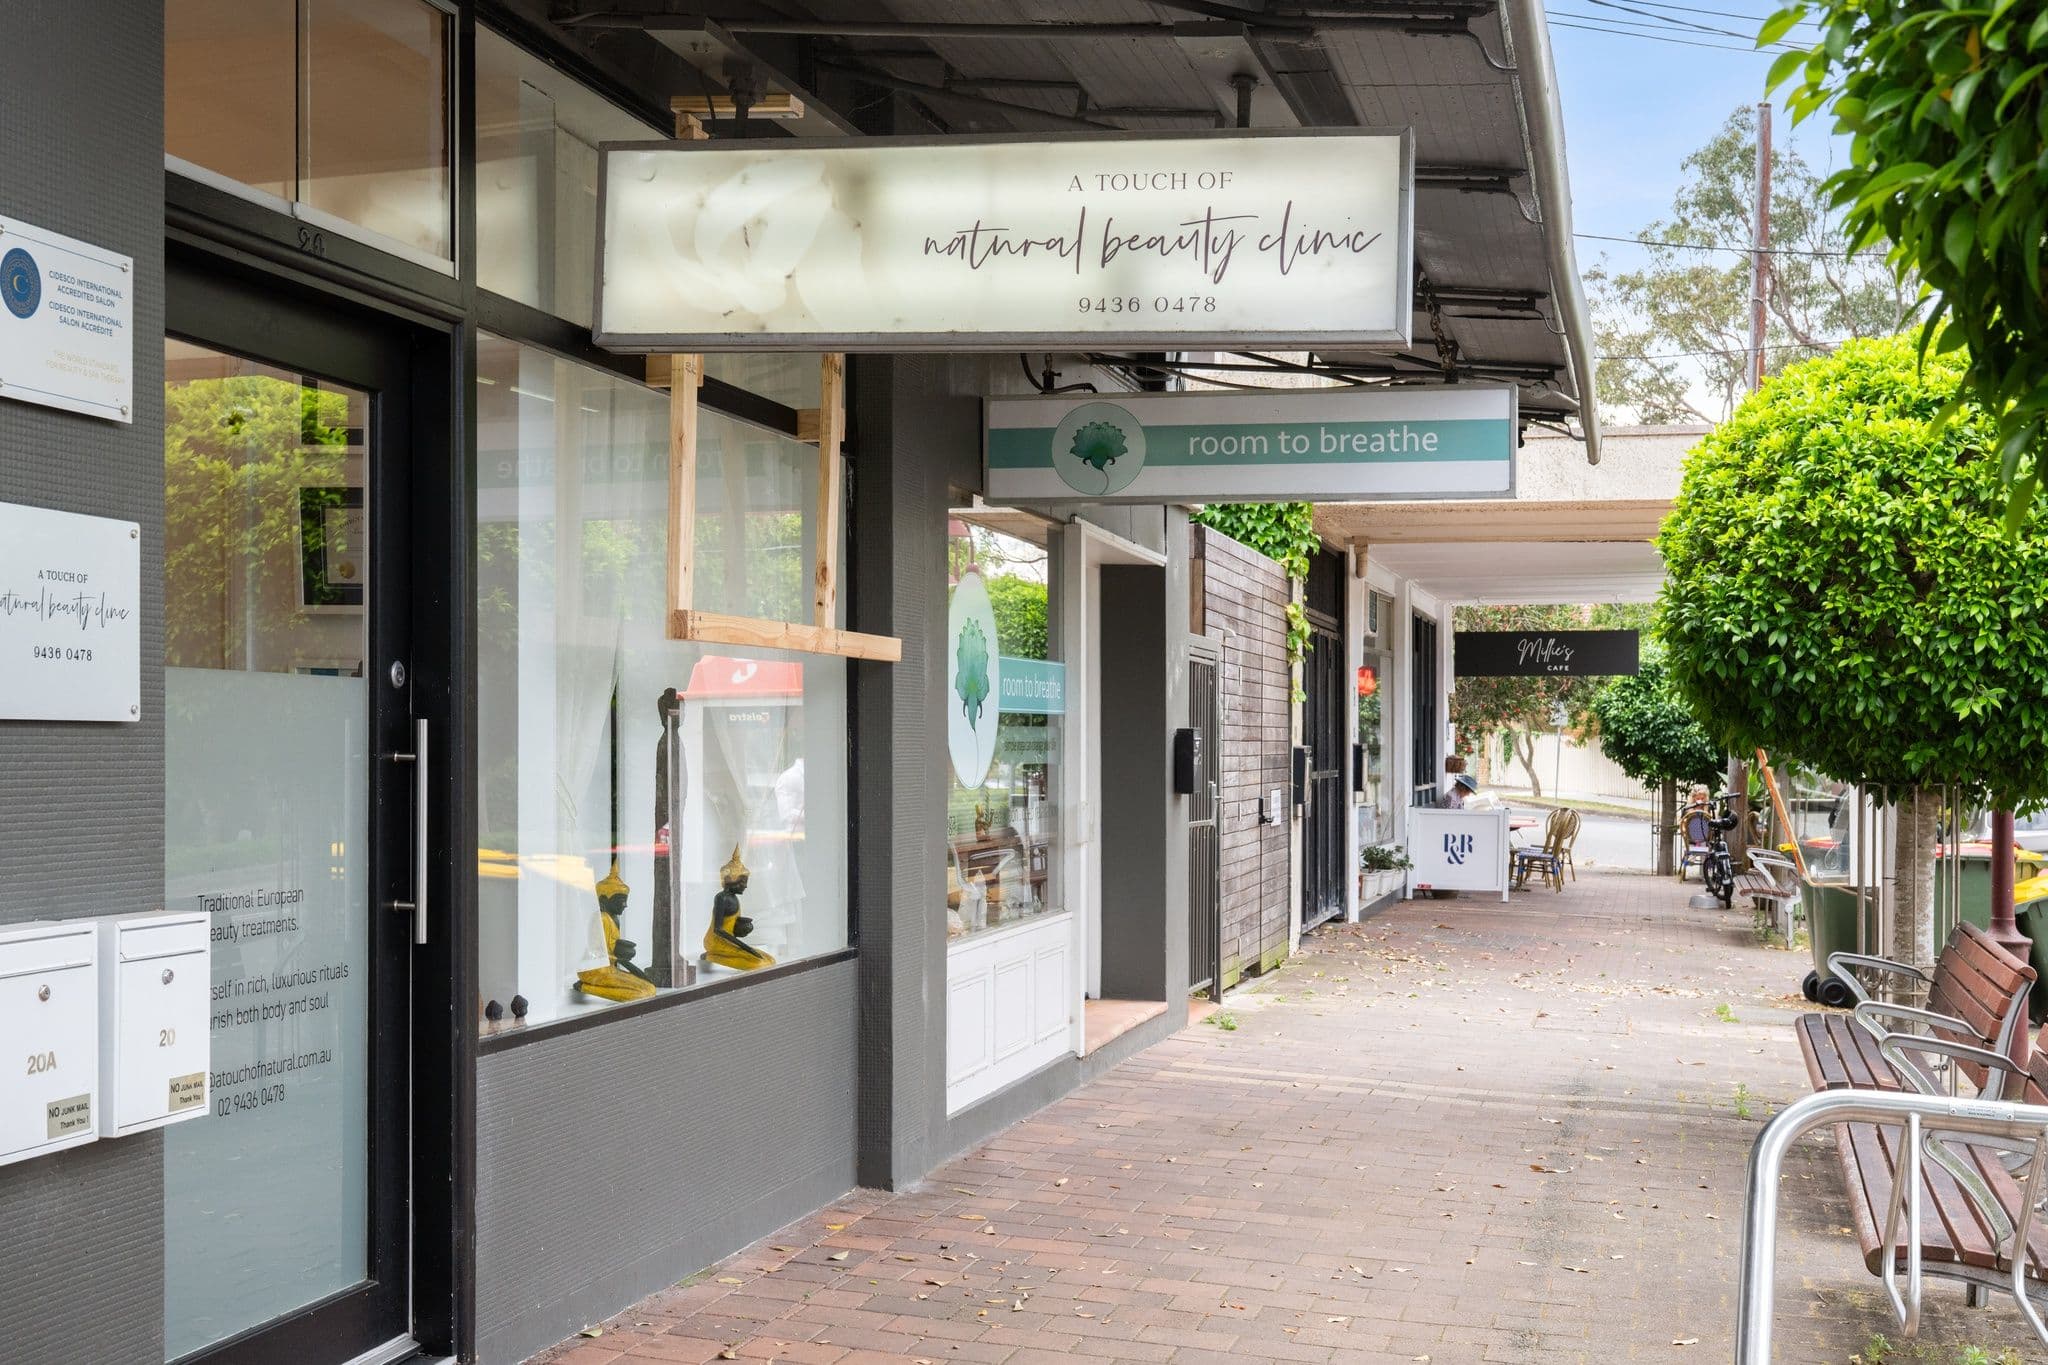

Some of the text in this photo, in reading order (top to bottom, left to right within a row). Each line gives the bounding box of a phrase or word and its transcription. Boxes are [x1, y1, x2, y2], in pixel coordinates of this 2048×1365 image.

[1067, 171, 1234, 192] A TOUCH OF
[924, 201, 1382, 285] natural beauty clinic
[48, 270, 123, 299] CIDESCO INTERNATIONAL
[57, 285, 115, 308] ACCREDITED SALON
[48, 300, 123, 328] CIDESCO INTERNATIONAL
[1077, 296, 1217, 314] 9436 0478
[59, 315, 79, 328] SALON
[1188, 424, 1440, 457] room to breathe
[38, 569, 88, 584] A TOUCH OF
[0, 586, 45, 622] atural
[48, 591, 97, 631] beauty
[33, 645, 93, 662] 9436 0478
[1546, 664, 1570, 672] CAFE
[1002, 673, 1061, 700] room to breathe
[198, 887, 304, 912] Traditional European
[210, 917, 299, 943] eauty treatments.
[210, 962, 349, 1002] self in rich, luxurious rituals
[236, 1006, 260, 1025] both
[262, 1000, 287, 1021] body
[288, 995, 307, 1014] and
[309, 991, 329, 1011] soul
[159, 1028, 176, 1047] 20
[26, 1050, 57, 1075] 20A
[170, 1082, 180, 1094] NO
[217, 1083, 285, 1117] 02 9436 0478
[48, 1102, 89, 1119] NO JUNK MAIL
[60, 1119, 75, 1129] Thank
[76, 1117, 86, 1125] You
